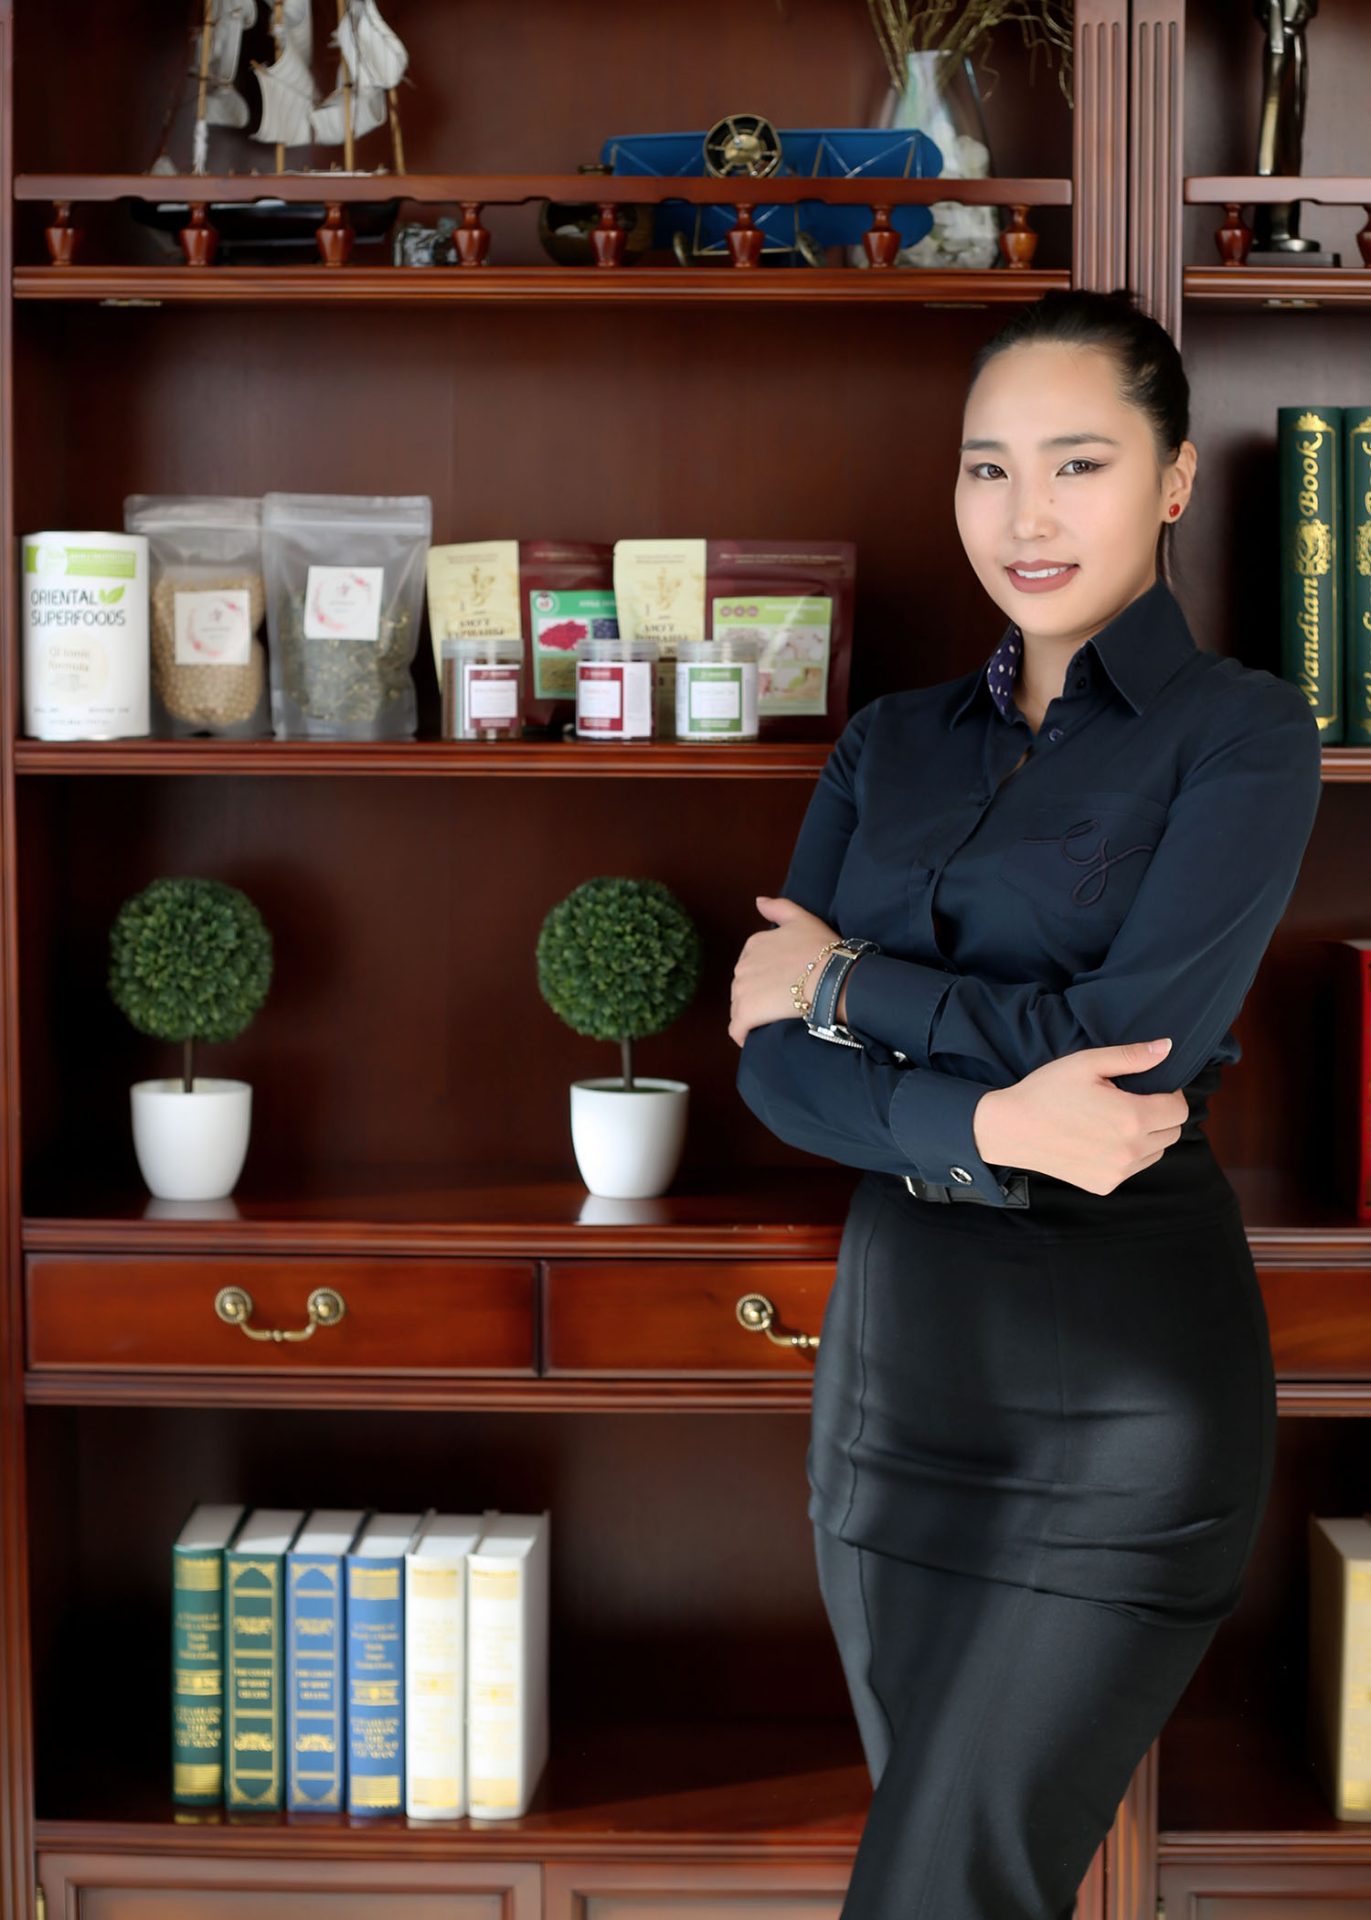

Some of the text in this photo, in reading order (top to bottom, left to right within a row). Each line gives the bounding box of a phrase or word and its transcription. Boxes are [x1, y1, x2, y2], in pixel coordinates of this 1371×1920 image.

[1296, 432, 1324, 706] Wandian Book
[31, 589, 98, 606] ORIENTAL
[31, 609, 126, 627] SUPERFOODS
